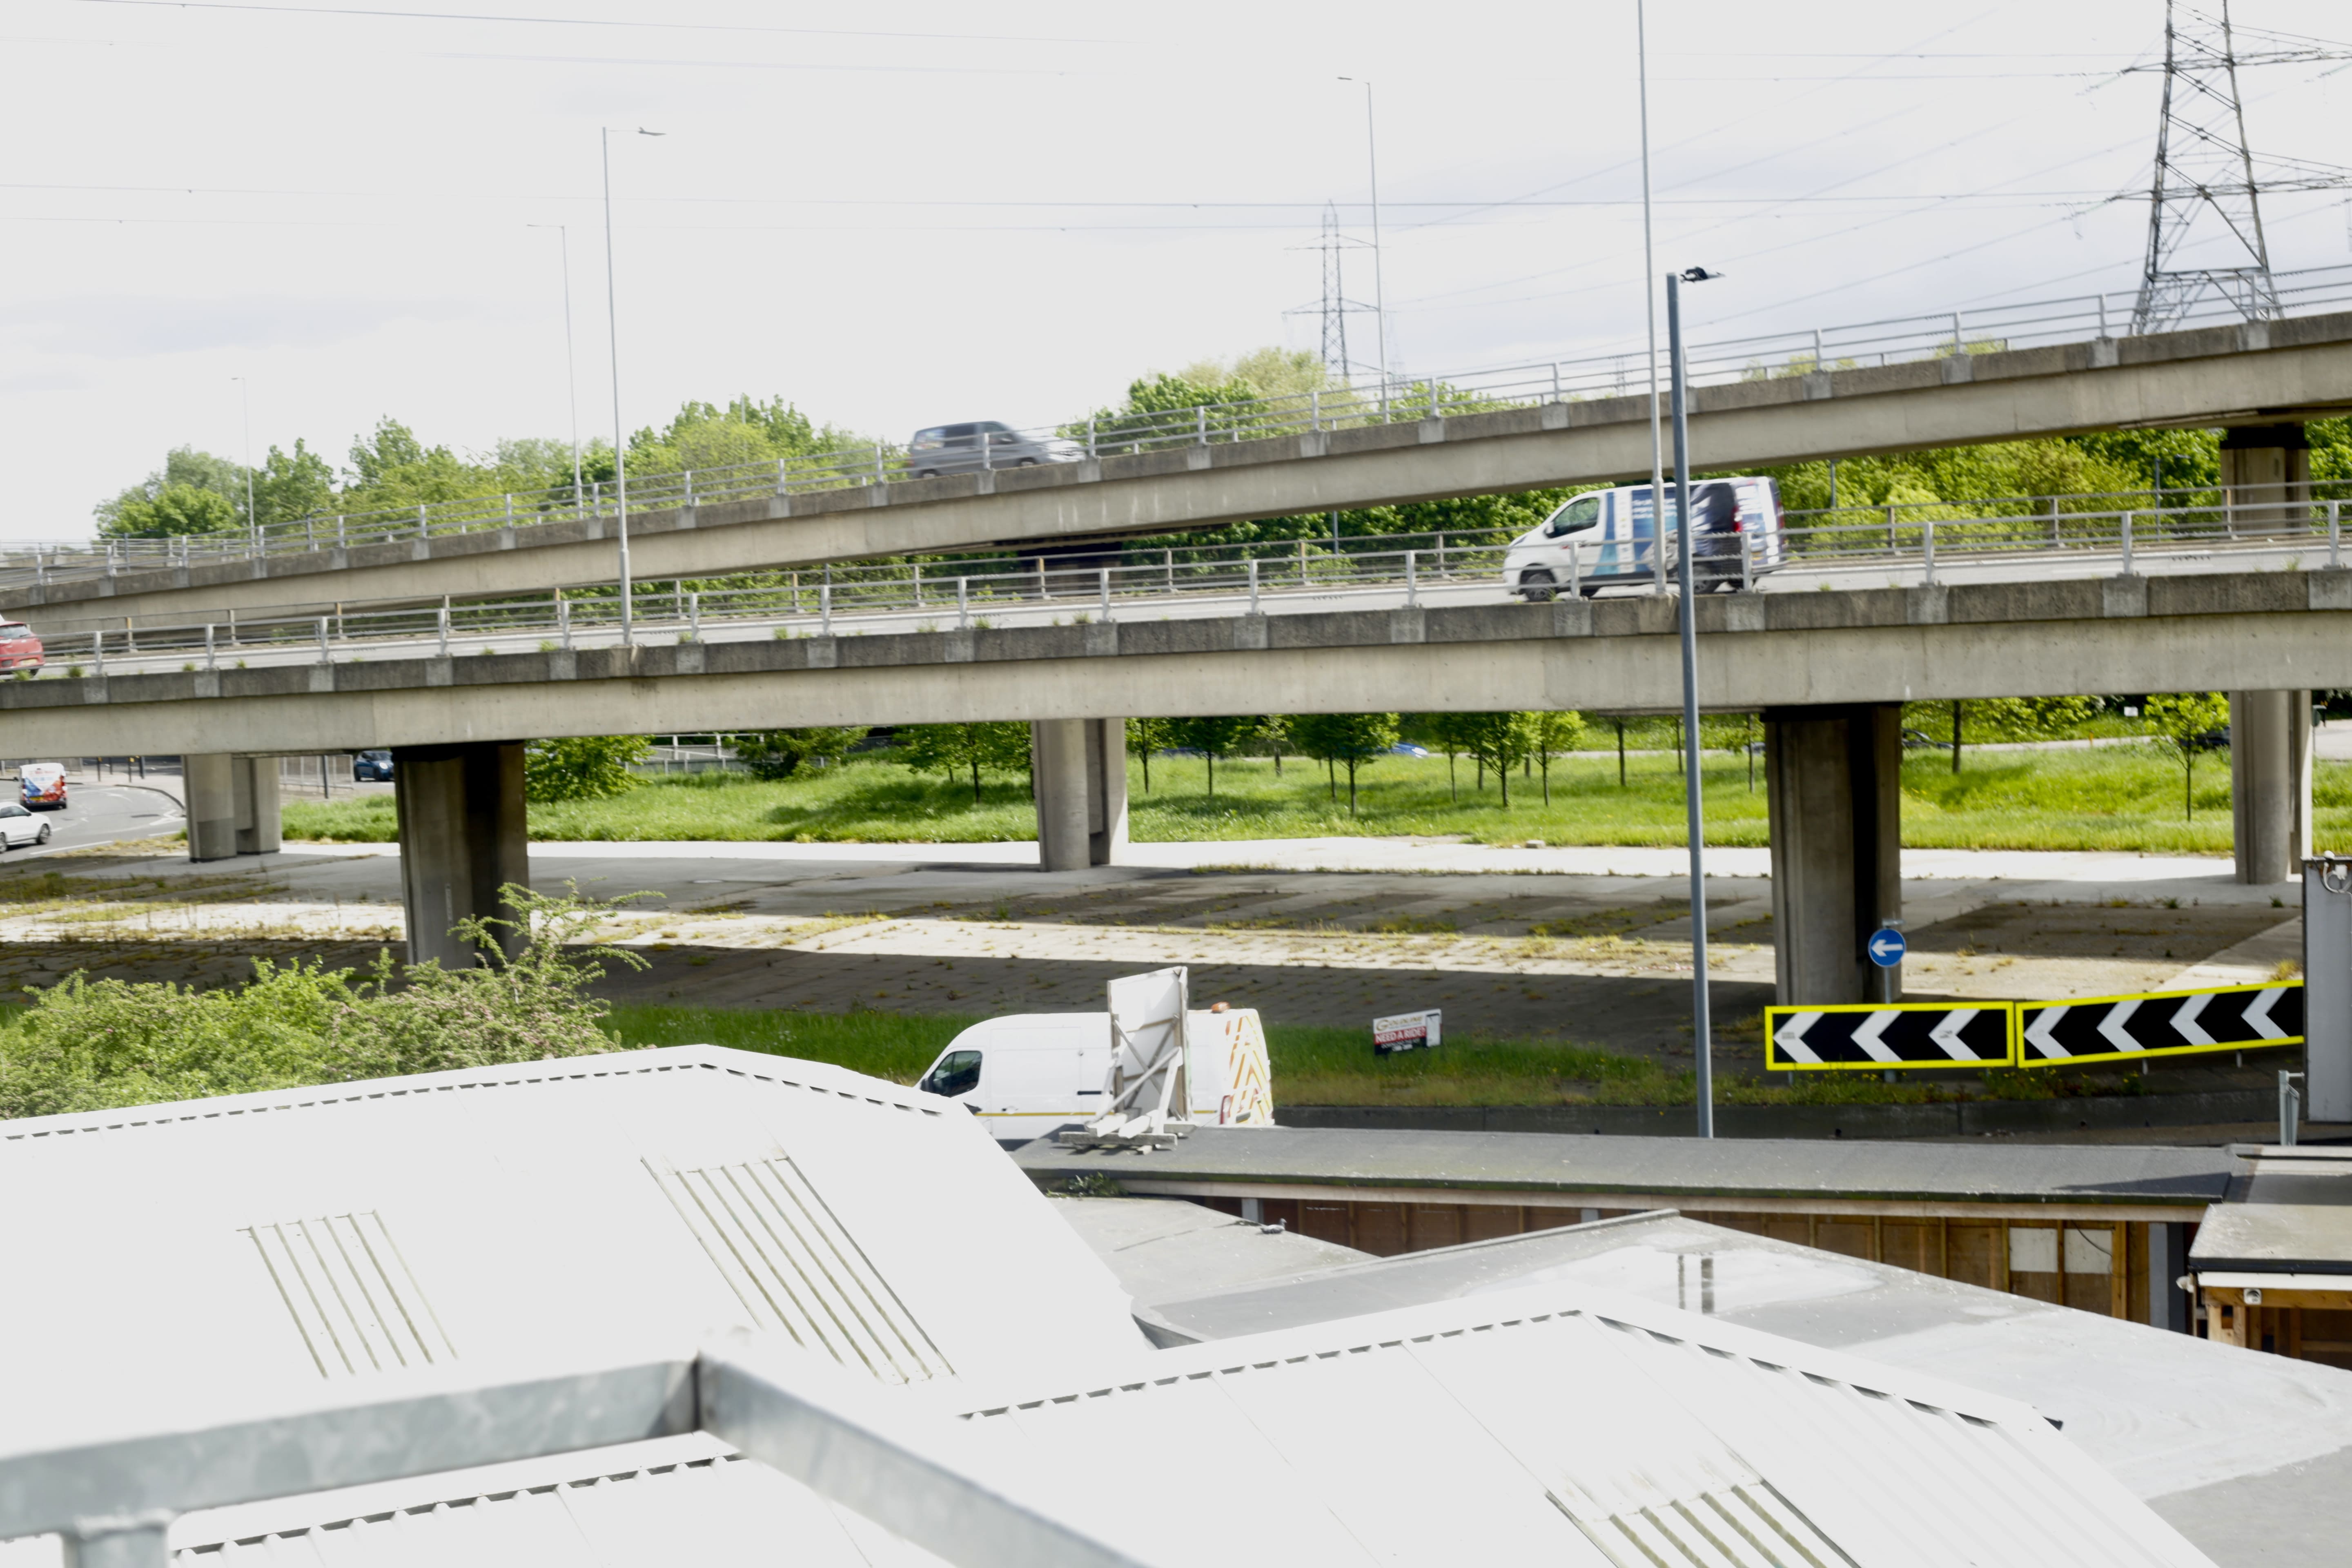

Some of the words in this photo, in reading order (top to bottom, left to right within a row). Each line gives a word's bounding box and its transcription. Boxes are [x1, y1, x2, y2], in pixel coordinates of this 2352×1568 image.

[1375, 1032, 1397, 1043] NEED
[1397, 1030, 1404, 1040] A
[1404, 1027, 1425, 1038] RIDE?
